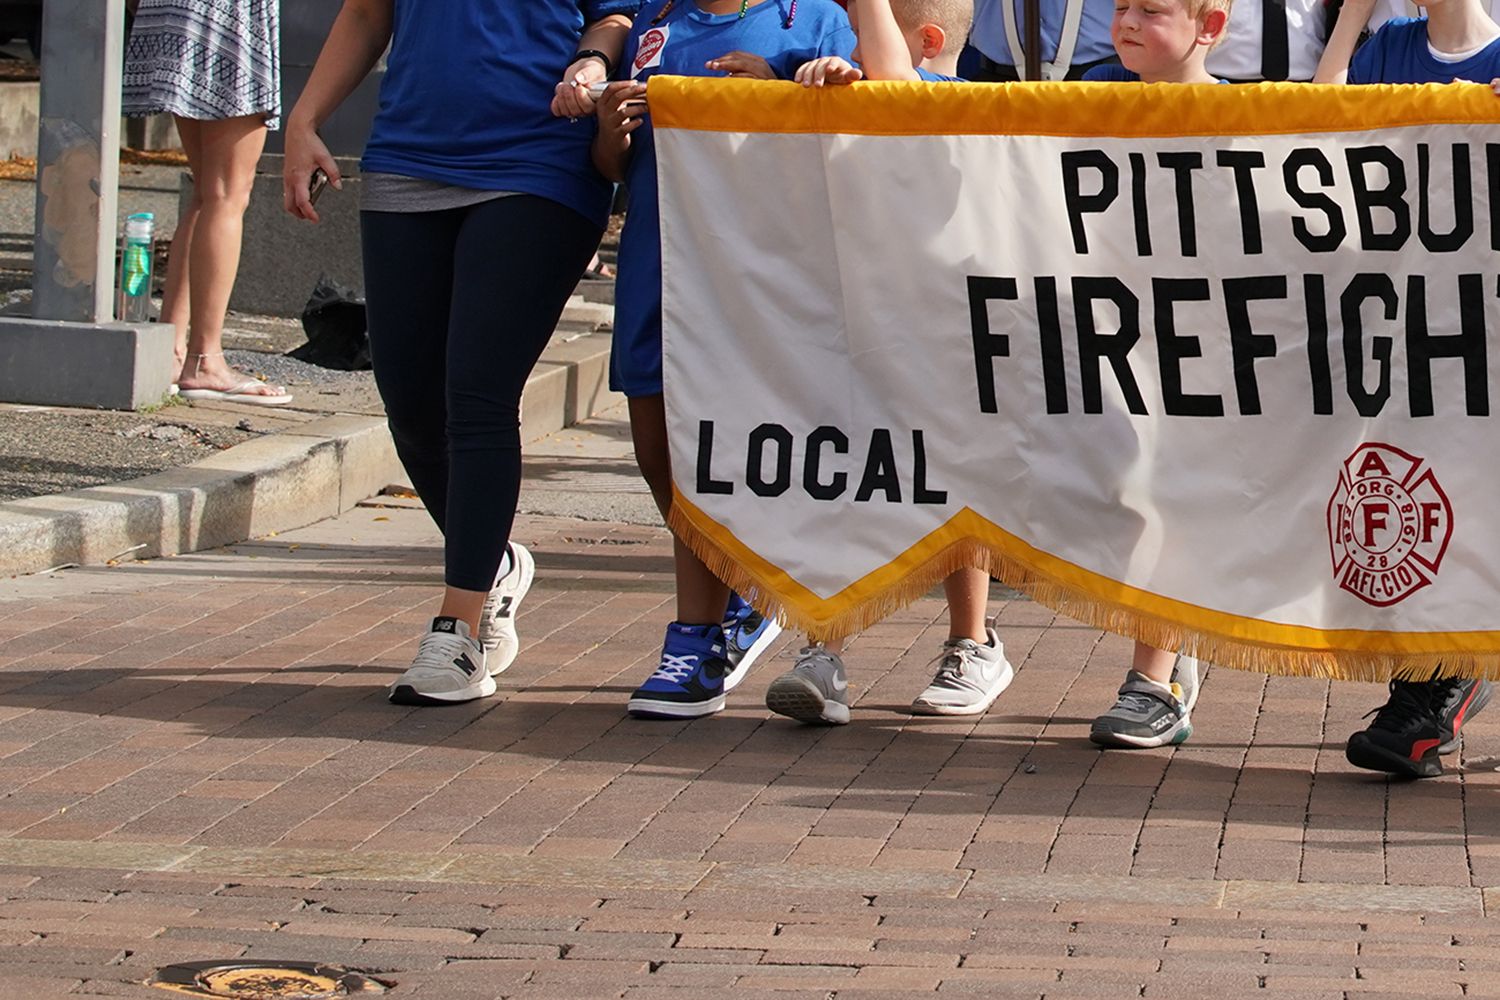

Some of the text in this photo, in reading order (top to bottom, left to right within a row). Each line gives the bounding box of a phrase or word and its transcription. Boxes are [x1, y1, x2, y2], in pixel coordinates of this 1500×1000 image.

[697, 420, 948, 505] LOCAL
[1356, 451, 1392, 477] A
[1357, 481, 1395, 496] ORG
[1361, 503, 1390, 547] F
[1420, 502, 1441, 543] F
[1401, 503, 1416, 545] 1918
[1367, 555, 1388, 568] 28
[1348, 565, 1413, 598] AFL-CIO
[453, 652, 477, 677] N
